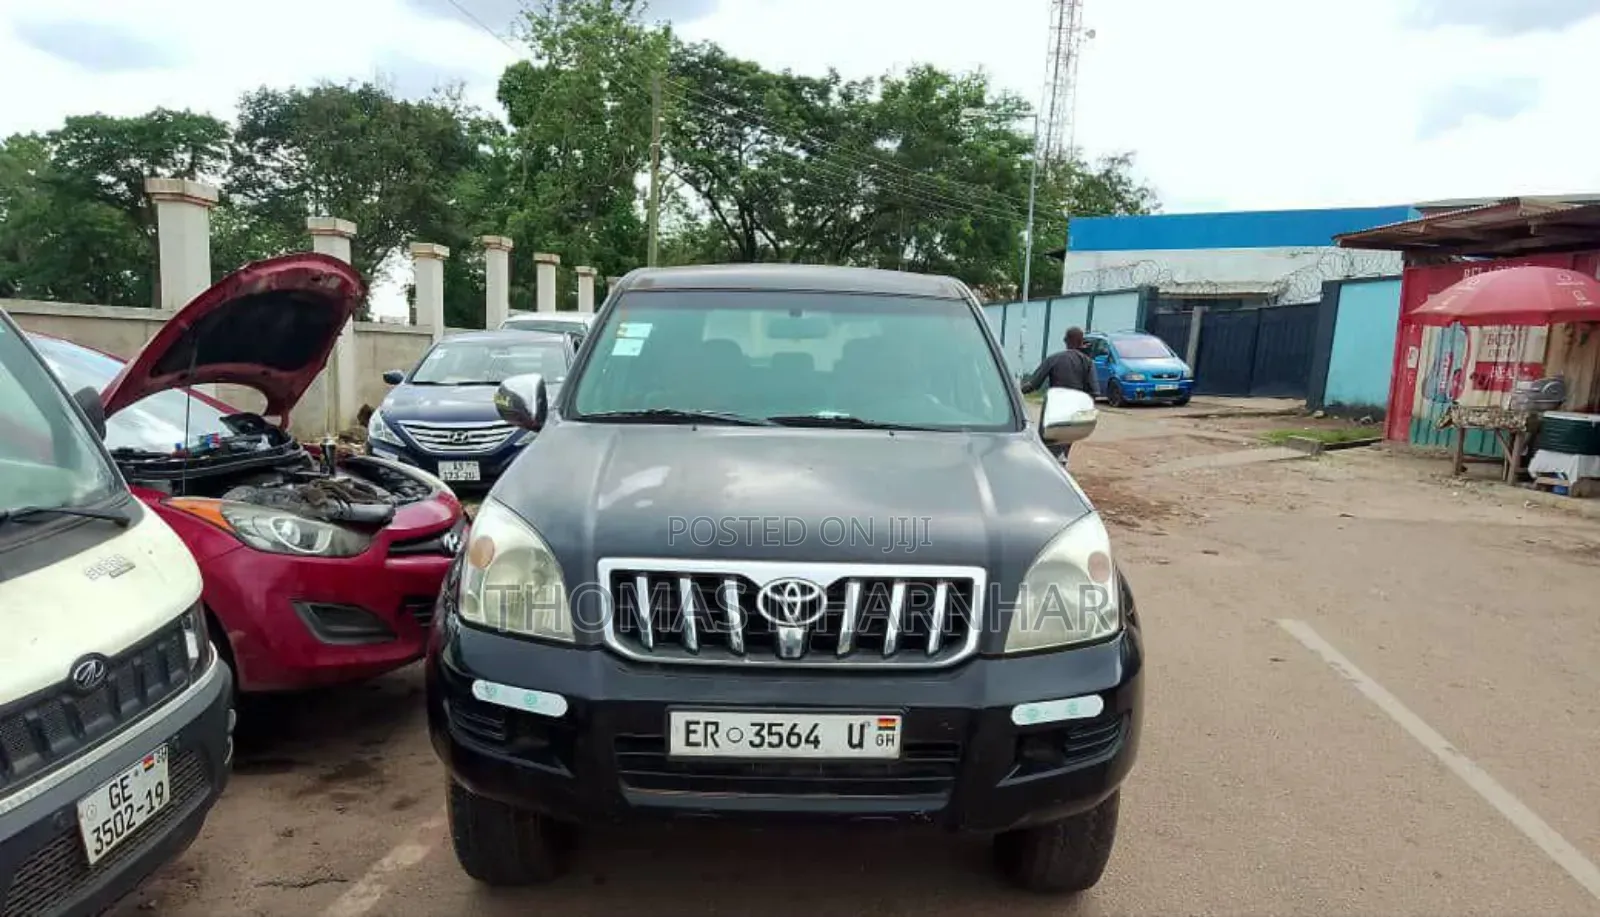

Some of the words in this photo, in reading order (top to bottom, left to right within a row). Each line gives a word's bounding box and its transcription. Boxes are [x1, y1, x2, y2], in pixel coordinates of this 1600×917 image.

[684, 720, 720, 748] ER
[749, 723, 821, 749] 3564
[876, 733, 895, 747] GH
[108, 775, 133, 810] GE
[91, 781, 164, 856] 3502-19
